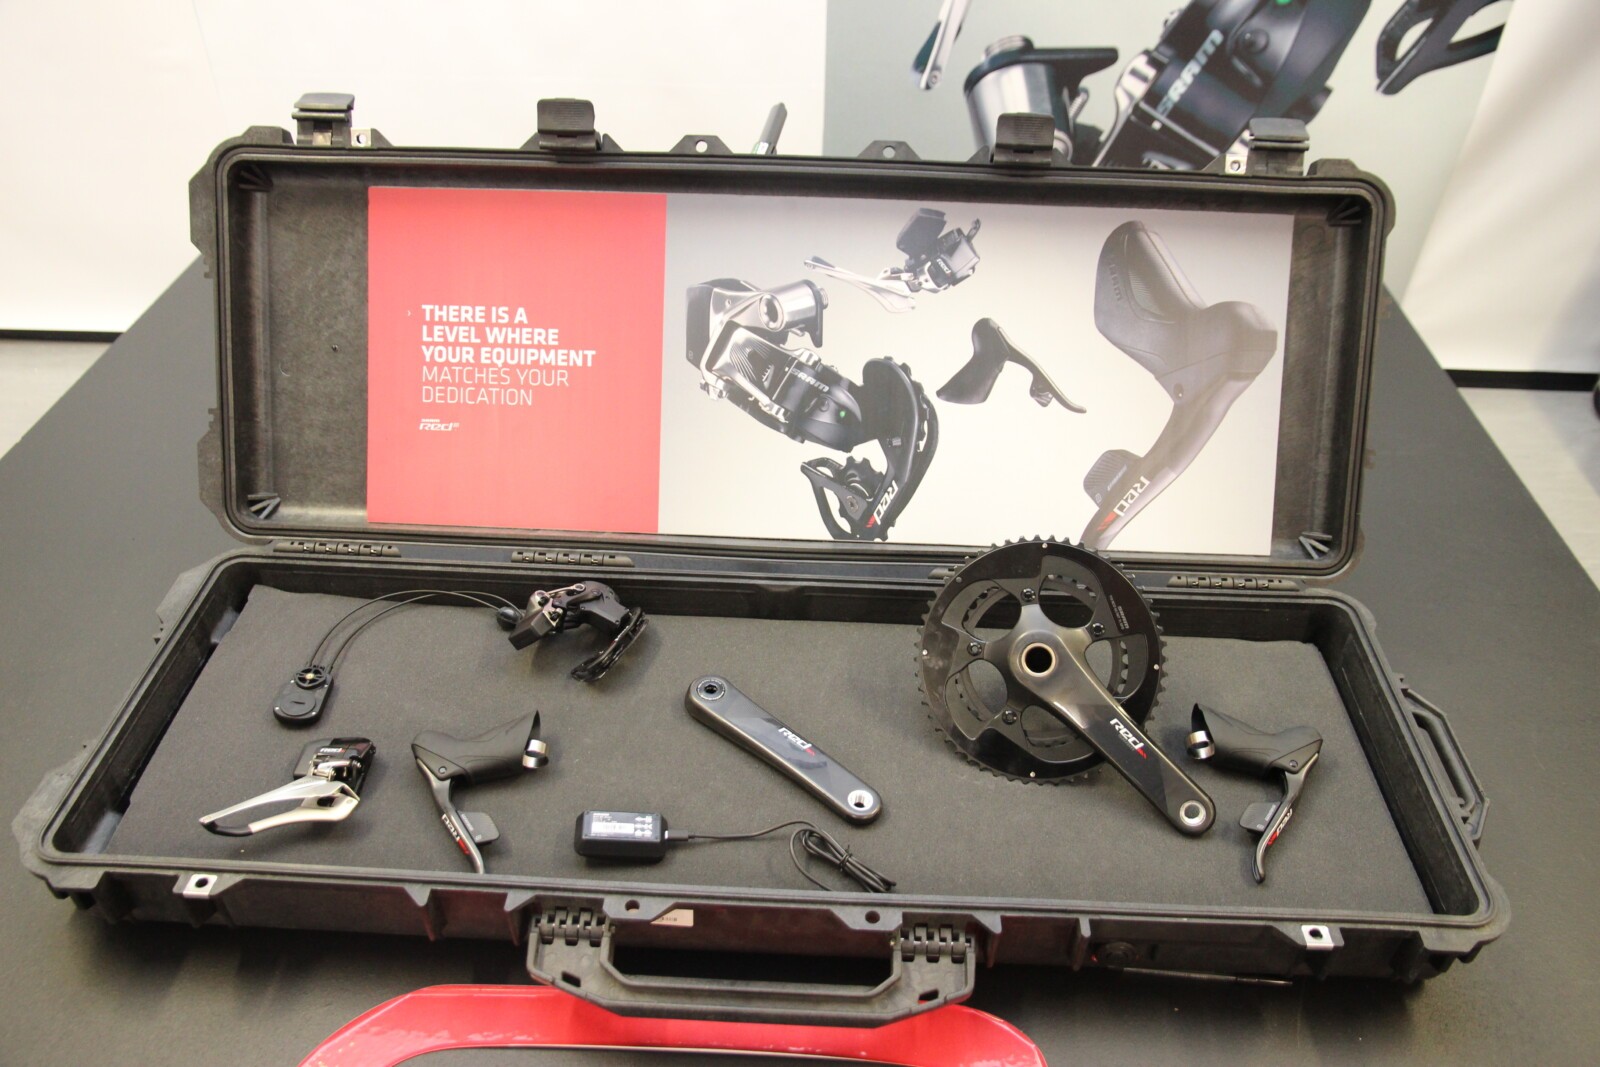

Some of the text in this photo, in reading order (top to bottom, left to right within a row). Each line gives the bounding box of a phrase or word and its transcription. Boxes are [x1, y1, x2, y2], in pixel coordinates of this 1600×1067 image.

[421, 304, 529, 324] THERE IS A
[422, 325, 559, 345] LEVEL WHERE
[421, 345, 597, 367] YOUR EQUIPMENT
[422, 366, 569, 387] MATCHES YOUR
[422, 386, 533, 406] DEDICATION
